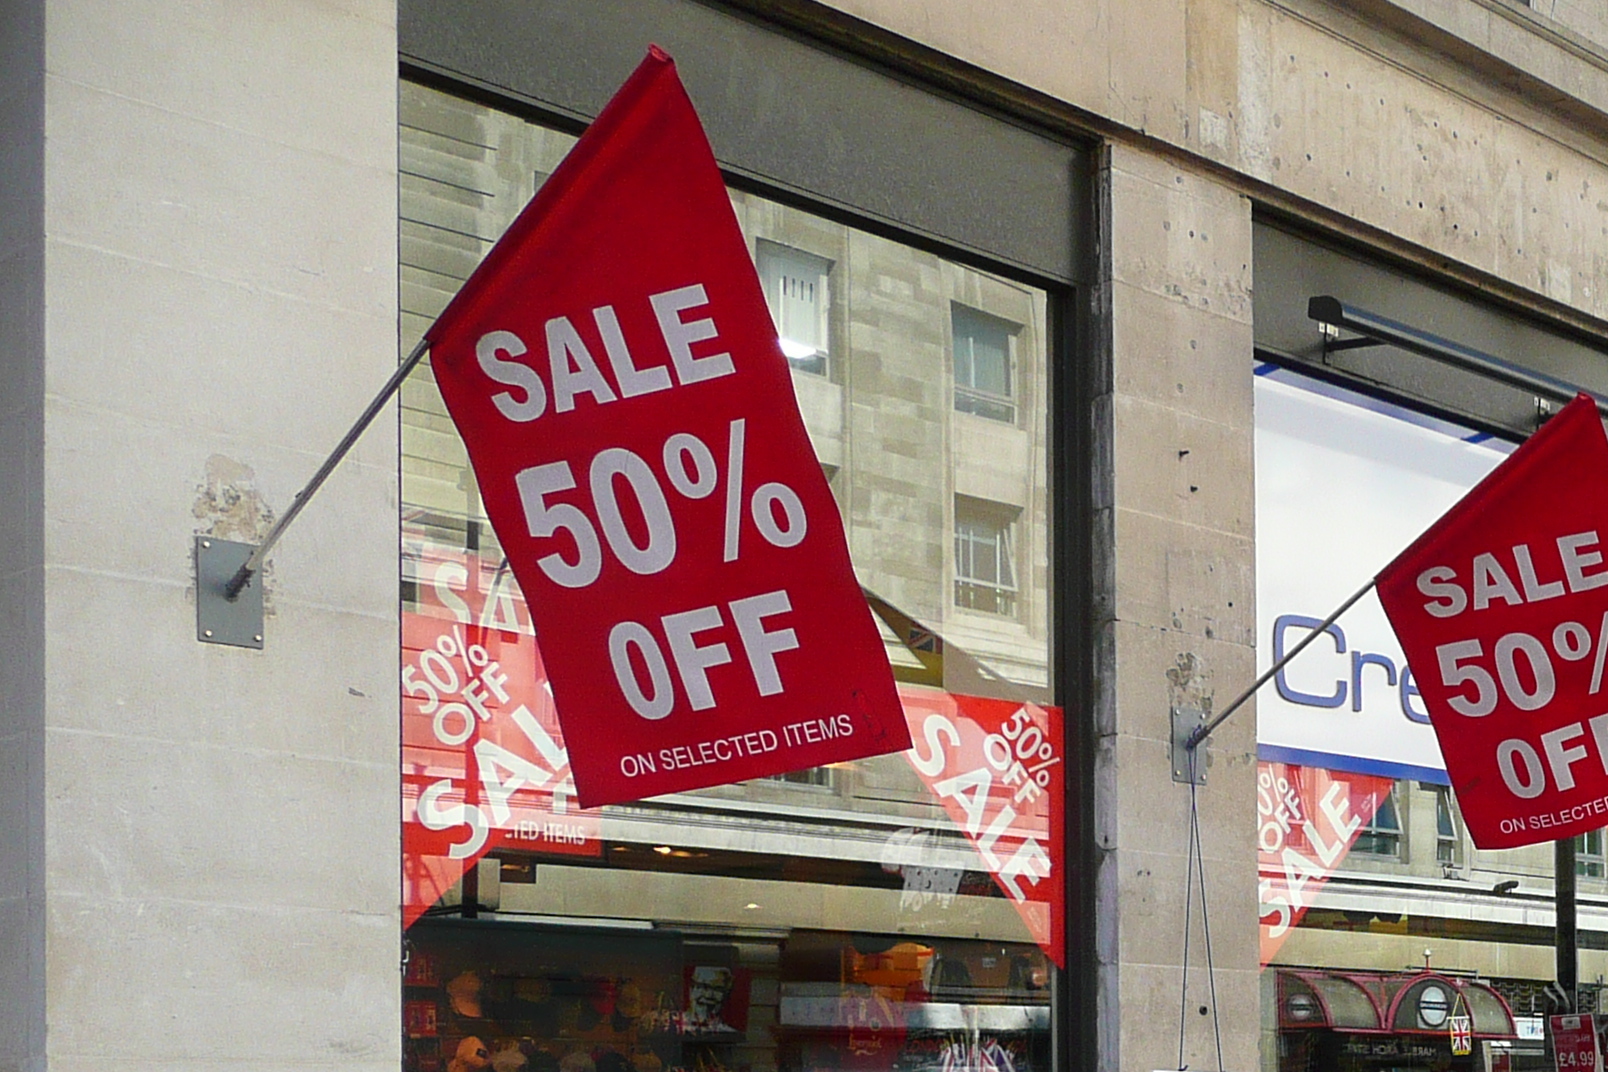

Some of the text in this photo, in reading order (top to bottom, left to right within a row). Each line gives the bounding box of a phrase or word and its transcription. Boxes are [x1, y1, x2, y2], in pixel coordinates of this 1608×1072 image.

[475, 283, 736, 423] SALE
[515, 418, 808, 589] 50%
[402, 625, 489, 715] 50%
[607, 591, 800, 722] OFF
[433, 661, 510, 745] OFF
[620, 713, 855, 779] ON SELECTED ITEMS
[417, 696, 570, 859] SAL
[983, 733, 1042, 805] OFF
[1002, 707, 1060, 788] 50%
[907, 714, 1052, 905] SALE
[1260, 789, 1301, 854] OFF
[1500, 817, 1527, 835] ON
[1259, 781, 1362, 939] SALE
[1558, 1050, 1594, 1067] £4.99
